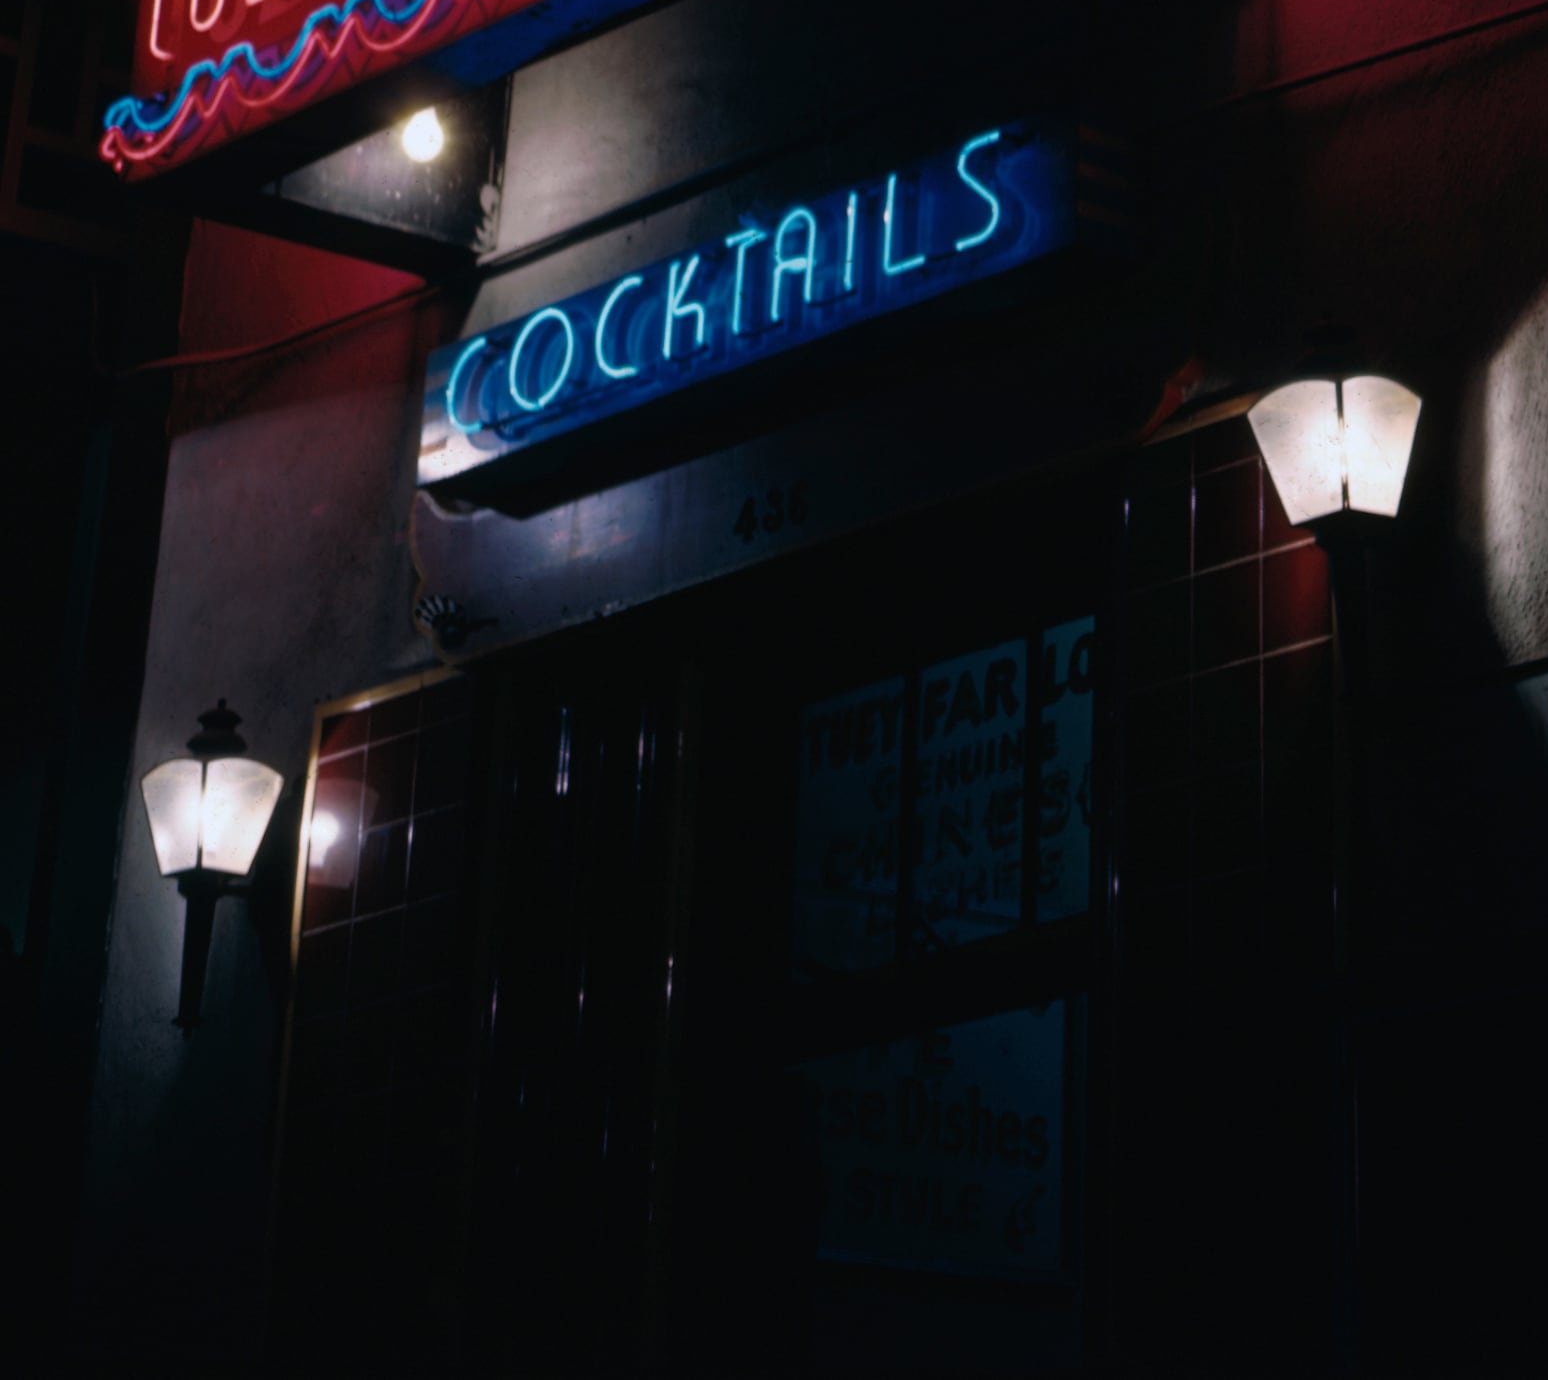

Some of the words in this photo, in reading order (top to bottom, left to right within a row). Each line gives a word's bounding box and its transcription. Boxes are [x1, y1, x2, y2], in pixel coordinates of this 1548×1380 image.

[446, 129, 1001, 434] COCKTAILS
[922, 657, 1020, 745] FAR
[896, 1076, 1049, 1172] Dishes
